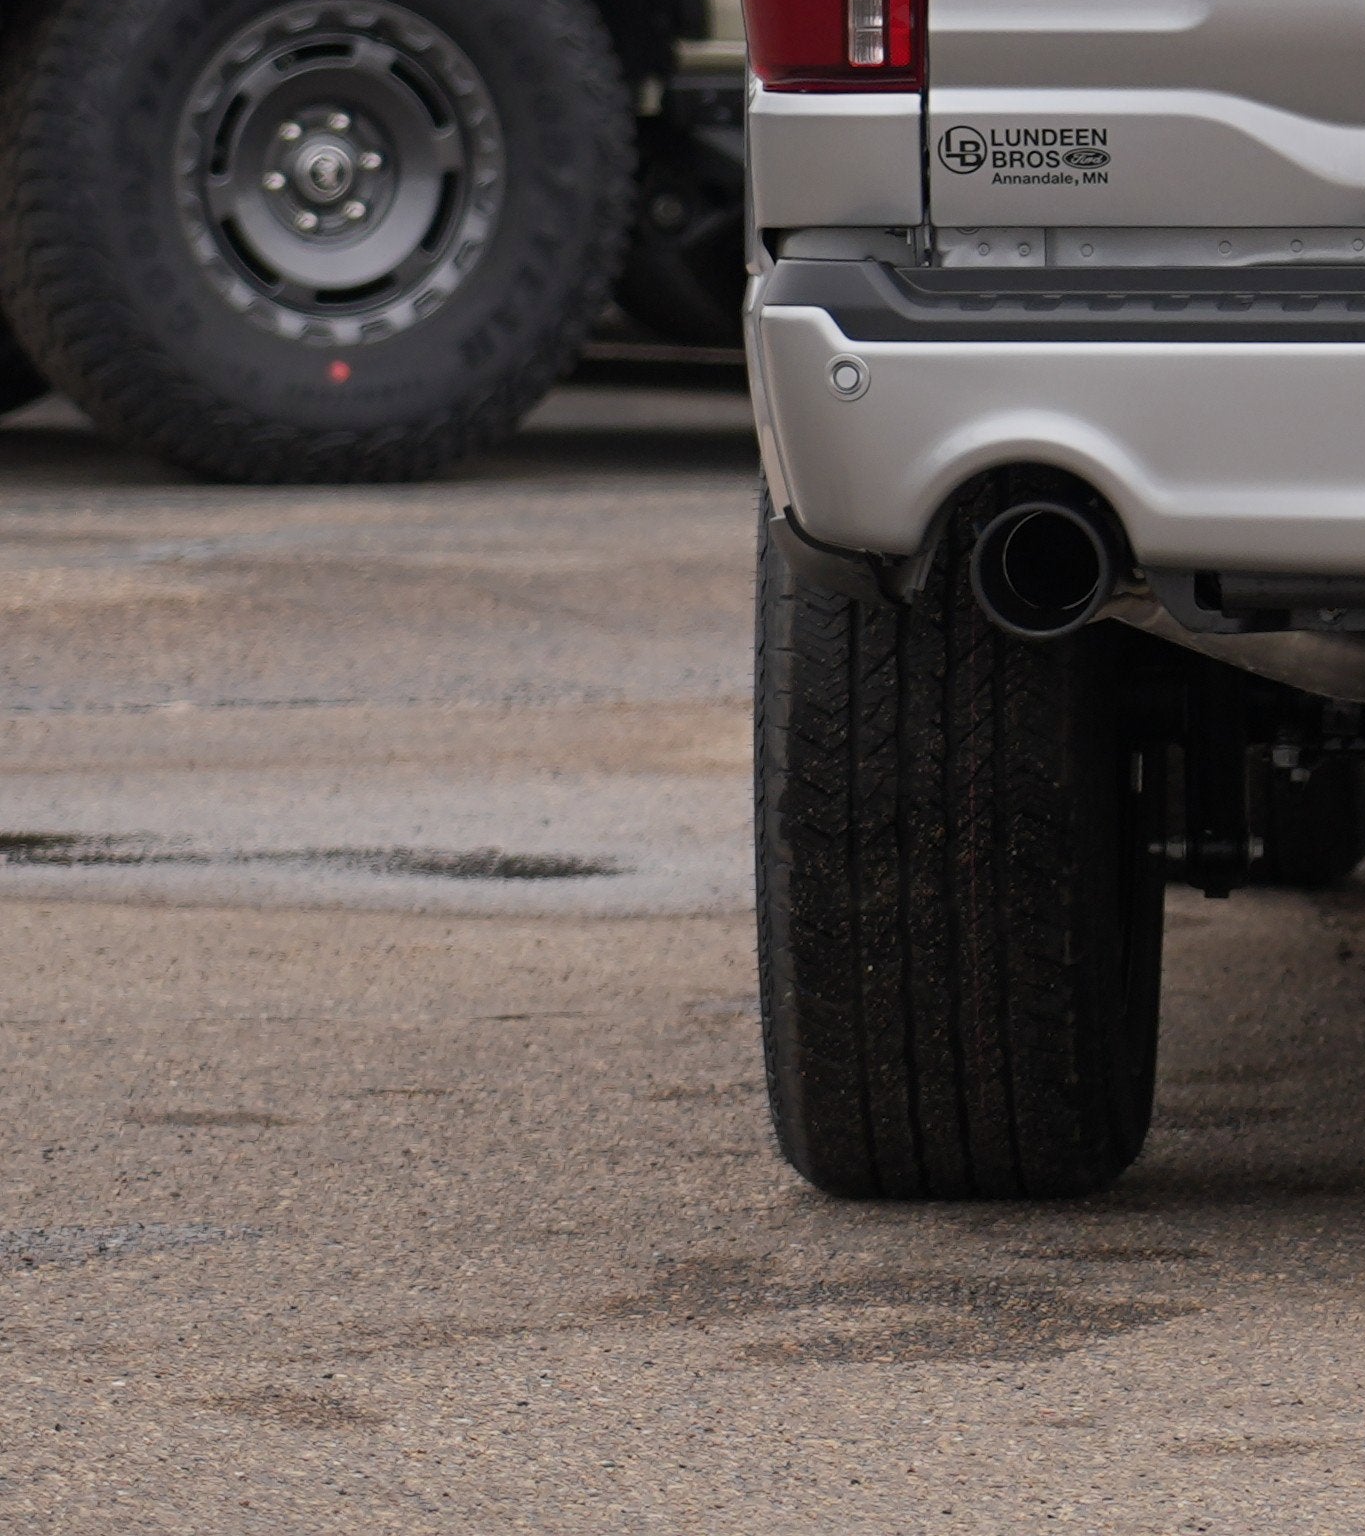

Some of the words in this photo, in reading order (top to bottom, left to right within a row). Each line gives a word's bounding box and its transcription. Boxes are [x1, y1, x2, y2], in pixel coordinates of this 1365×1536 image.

[991, 128, 1107, 147] LUNDEEN
[992, 150, 1060, 169] BROS
[991, 172, 1079, 187] Annandale,
[1082, 172, 1109, 184] MN
